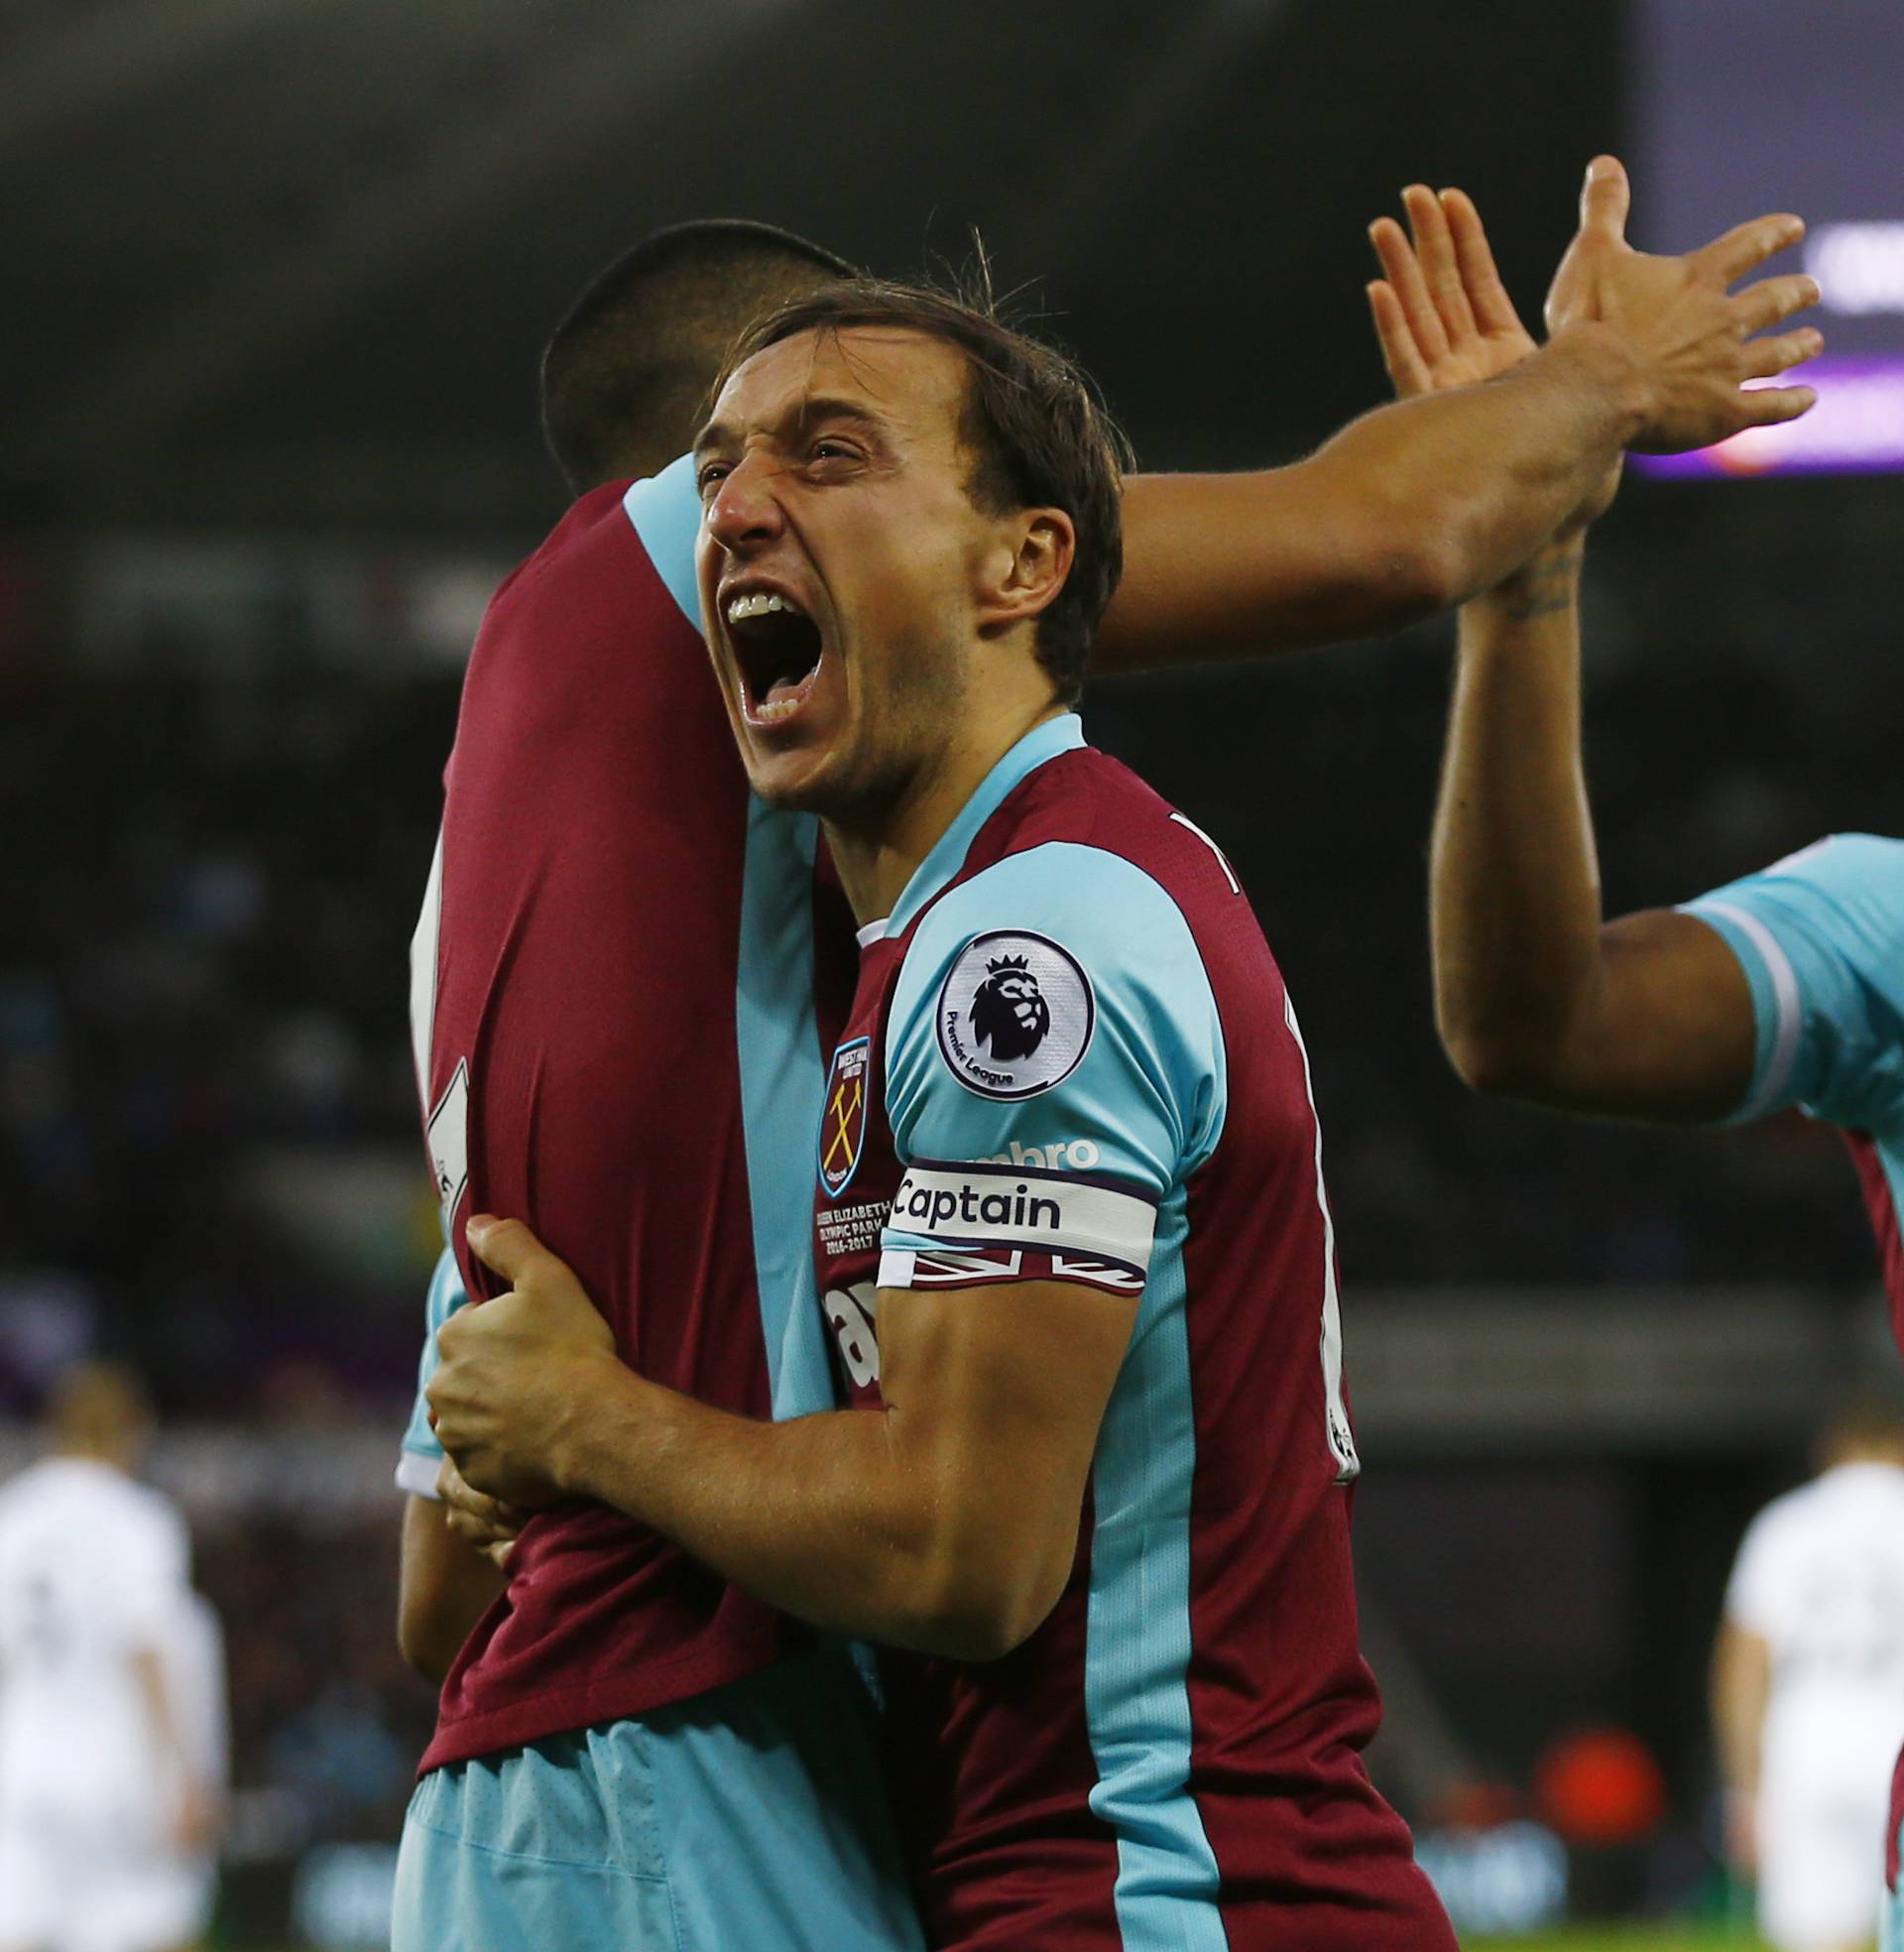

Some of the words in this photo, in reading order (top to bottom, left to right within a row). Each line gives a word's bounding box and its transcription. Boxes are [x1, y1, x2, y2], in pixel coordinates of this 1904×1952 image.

[946, 1010, 968, 1061] Premier
[965, 1056, 1013, 1085] League
[966, 1139, 1100, 1170] bro
[833, 1200, 892, 1223] ELIZABETH
[893, 1178, 1061, 1230] Captain
[852, 1218, 883, 1236] PARK
